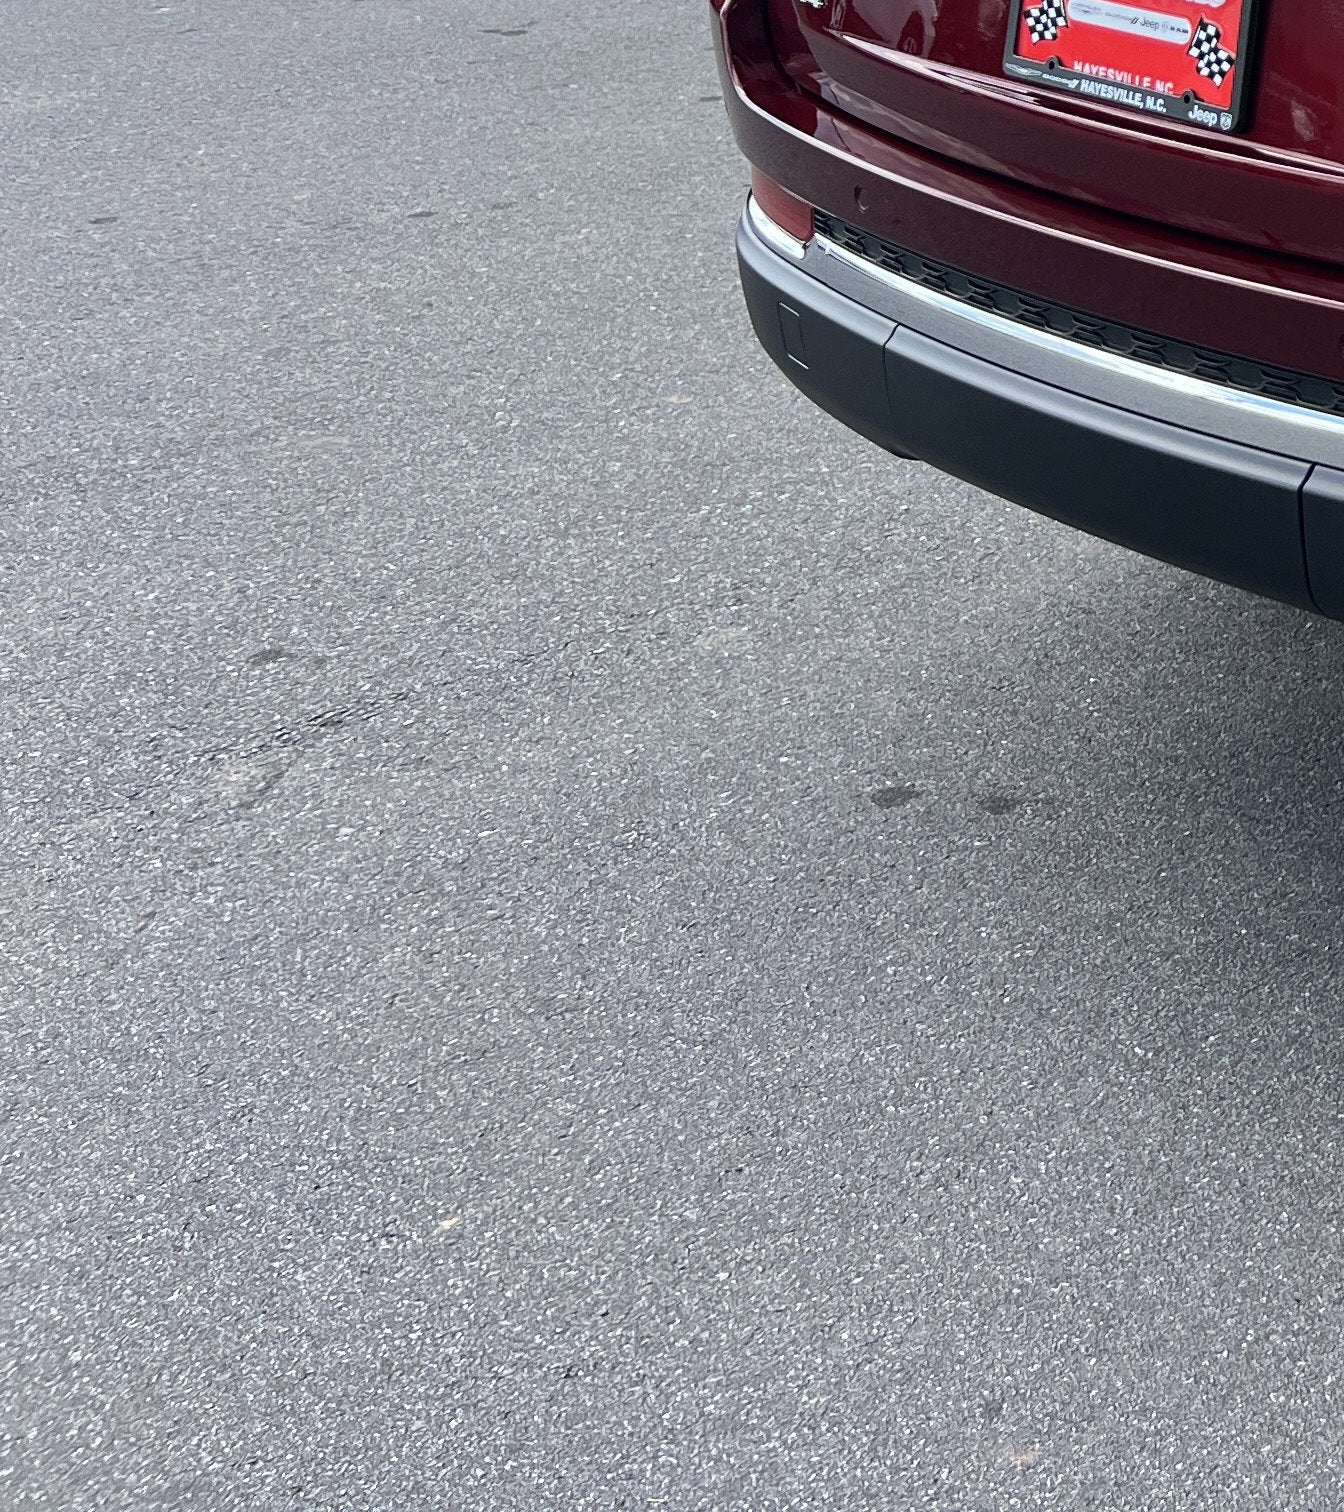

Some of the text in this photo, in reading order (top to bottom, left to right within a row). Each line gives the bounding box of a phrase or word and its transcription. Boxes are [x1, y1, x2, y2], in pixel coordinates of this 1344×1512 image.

[1140, 16, 1160, 30] Jeep
[1080, 79, 1167, 113] HAYESVILLE, N.C.
[1188, 105, 1218, 126] Jeep
